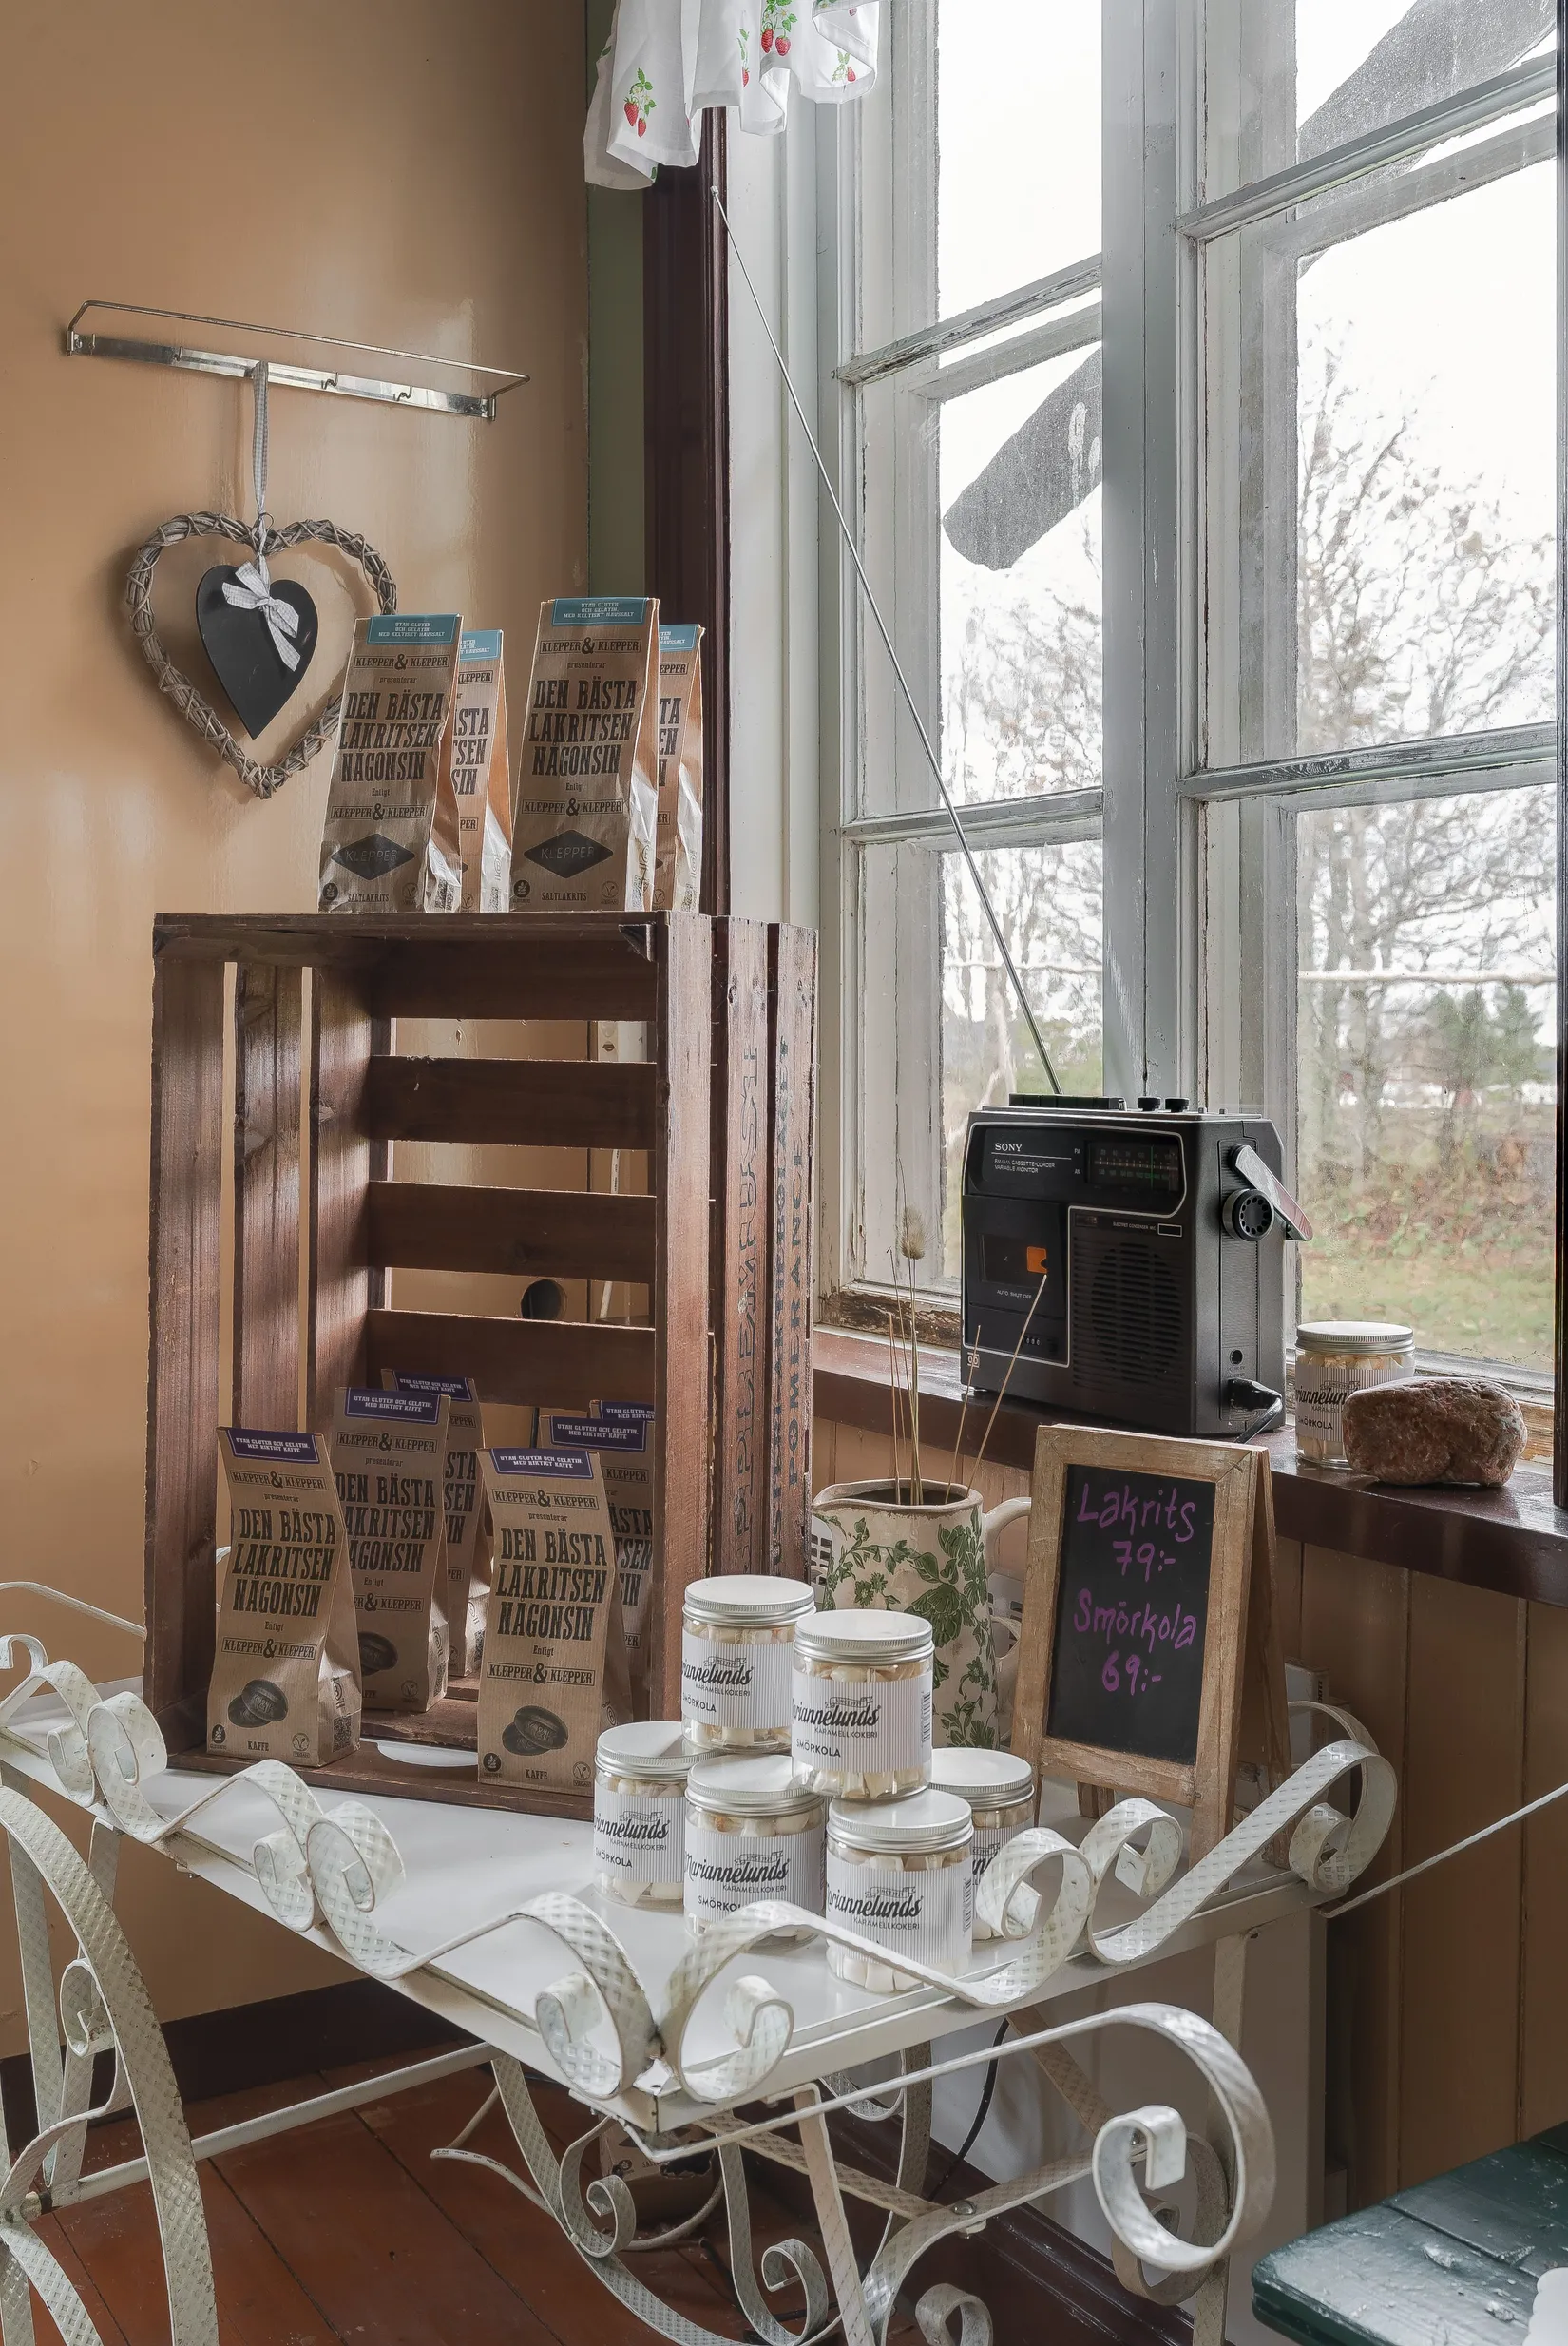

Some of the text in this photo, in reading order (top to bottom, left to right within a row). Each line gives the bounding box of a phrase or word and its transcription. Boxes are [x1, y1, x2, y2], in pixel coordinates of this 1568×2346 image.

[542, 637, 639, 654] KLEPPER & KLEPPER
[356, 654, 448, 670] KLEPPER & KLEPPER
[660, 663, 686, 675] EPPER
[533, 676, 637, 710] DEN BÄSTA
[345, 690, 445, 721] DEN BÄSTA
[454, 707, 489, 736] STA
[528, 713, 635, 742] LAKRITSEN
[338, 722, 439, 750] LAKRITSEN
[341, 747, 426, 782] NÅGONSIN
[531, 741, 622, 777] NÅGONSIN
[372, 788, 391, 798] Enligt
[566, 782, 583, 792] Enligt
[333, 803, 426, 820] KLEPPER & KLEPPER
[525, 798, 621, 817] KLEPPER & KLEPPER
[346, 850, 398, 862] KLEPPER
[541, 846, 595, 859] KLEPPER
[348, 894, 390, 903] SALTLAKRITS
[542, 892, 587, 901] SALTLAKRITS
[995, 1143, 1023, 1152] SONY
[449, 1416, 473, 1427] EPPER
[339, 1433, 435, 1452] KLEPPER & KLEPPER
[365, 1456, 404, 1468] presenterar
[445, 1452, 476, 1480] STA
[232, 1471, 324, 1490] KLEPPER & KLEPPER
[606, 1469, 647, 1482] KLEPPER
[264, 1493, 299, 1503] presenterar
[335, 1472, 369, 1503] DEN
[376, 1473, 436, 1508] BÄSTA
[494, 1490, 597, 1509] KLEPPER & KLEPPER
[528, 1513, 568, 1522] presenterar
[610, 1503, 653, 1536] ÄSTA
[1077, 1483, 1196, 1543] Lakrits
[239, 1508, 336, 1545] DEN BÄSTA
[345, 1506, 436, 1540] AKRITSEN
[349, 1535, 426, 1573] ÅGONSIN
[501, 1528, 537, 1561] DEN
[545, 1528, 607, 1567] BÄSTA
[232, 1543, 335, 1581] LAKRITSEN
[1113, 1541, 1176, 1582] 79:-
[364, 1576, 384, 1587] Enligt
[495, 1564, 607, 1604] LAKRITSEN
[233, 1574, 322, 1617] NÅGONSIN
[364, 1593, 378, 1612] &
[380, 1599, 422, 1610] KLEPPER
[264, 1621, 285, 1632] Enligt
[498, 1598, 595, 1642] NÅGONSIN
[1074, 1587, 1197, 1653] Smörkola
[224, 1638, 315, 1659] KLEPPER & KLEPPER
[533, 1644, 555, 1657] Enligt
[489, 1663, 593, 1684] KLEPPER & KLEPPER
[1102, 1649, 1162, 1696] 69:-
[696, 1683, 751, 1697] KARAMELLKOKERI
[814, 1727, 878, 1739] KARAMELLKOKERI
[248, 1740, 270, 1752] KAFFE
[796, 1739, 841, 1758] SMÖRKOLA
[526, 1768, 548, 1780] KAFFE
[610, 1838, 667, 1851] KARAMELLKOKERI
[722, 1885, 787, 1894] KARAMELLKOKERI
[853, 1918, 920, 1931] KARAMELLKOKERI
